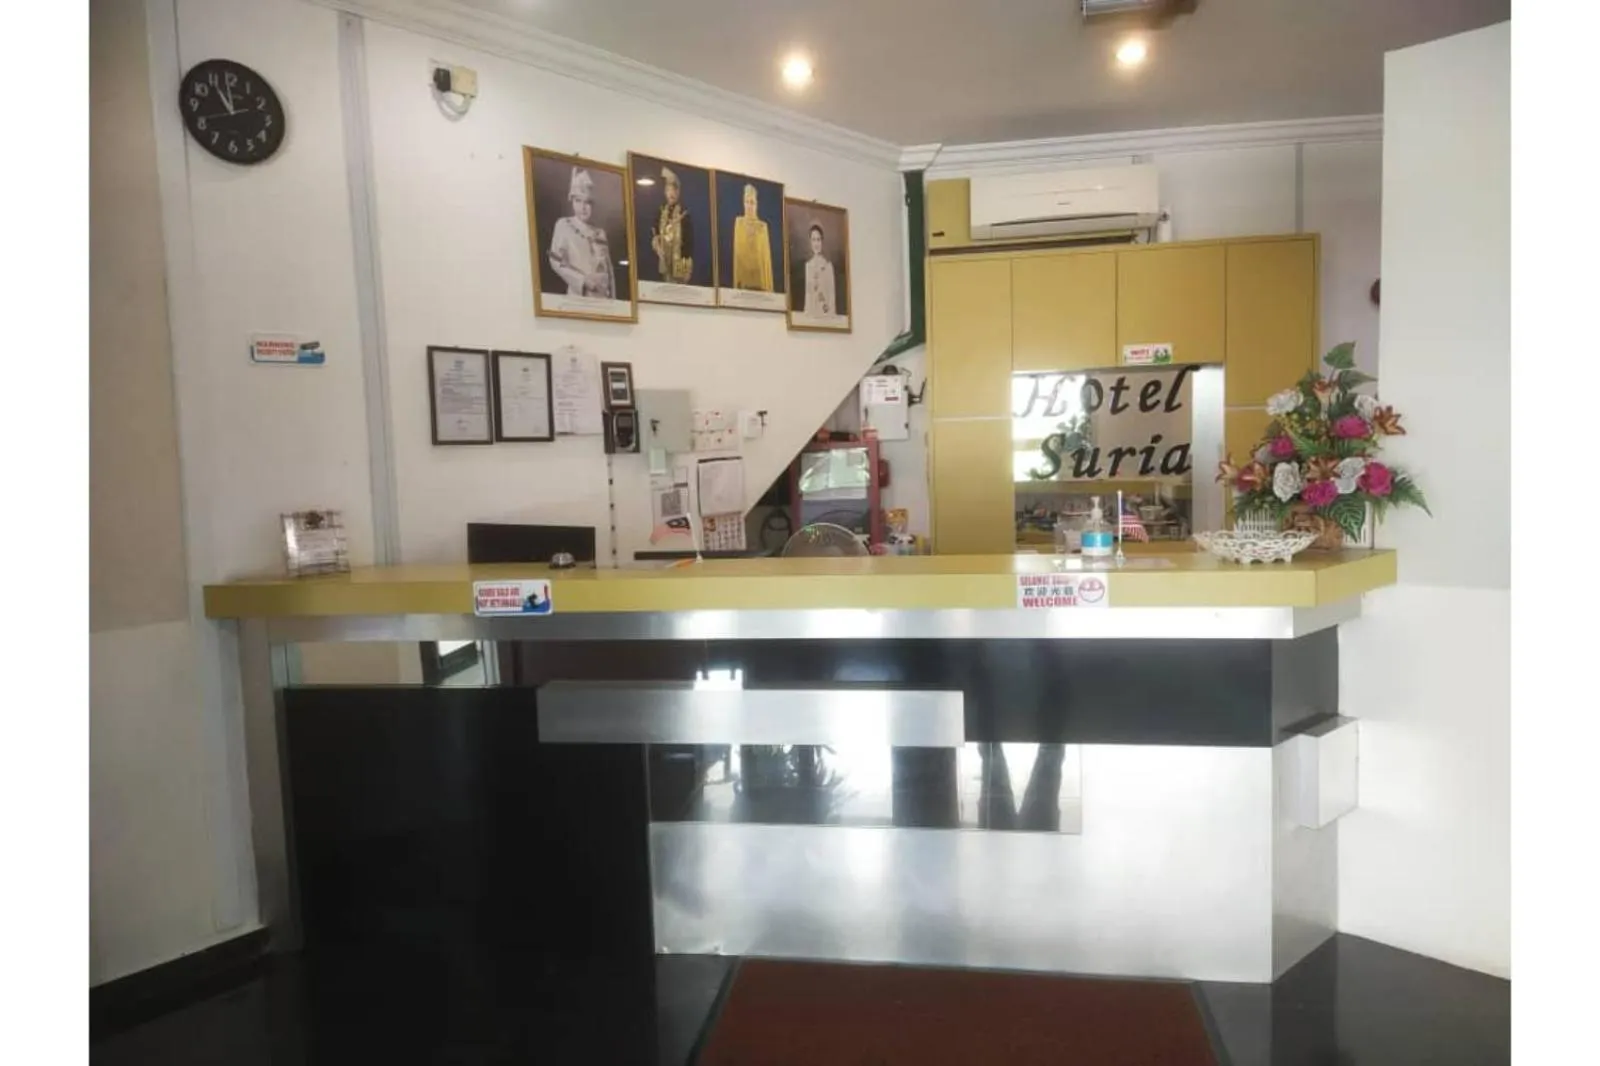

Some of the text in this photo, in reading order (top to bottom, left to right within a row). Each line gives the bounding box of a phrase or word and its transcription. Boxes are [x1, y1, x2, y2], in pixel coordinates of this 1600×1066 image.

[195, 82, 208, 97] 10
[245, 82, 251, 95] 1
[190, 98, 199, 112] 9
[257, 97, 266, 110] 2
[197, 116, 207, 130] 8
[211, 131, 219, 144] 7
[257, 130, 267, 142] 4
[228, 140, 238, 154] 6
[246, 139, 255, 152] 5
[1012, 364, 1201, 419] Hotel
[1028, 433, 1193, 481] Suria
[1022, 597, 1077, 608] WELCOME
